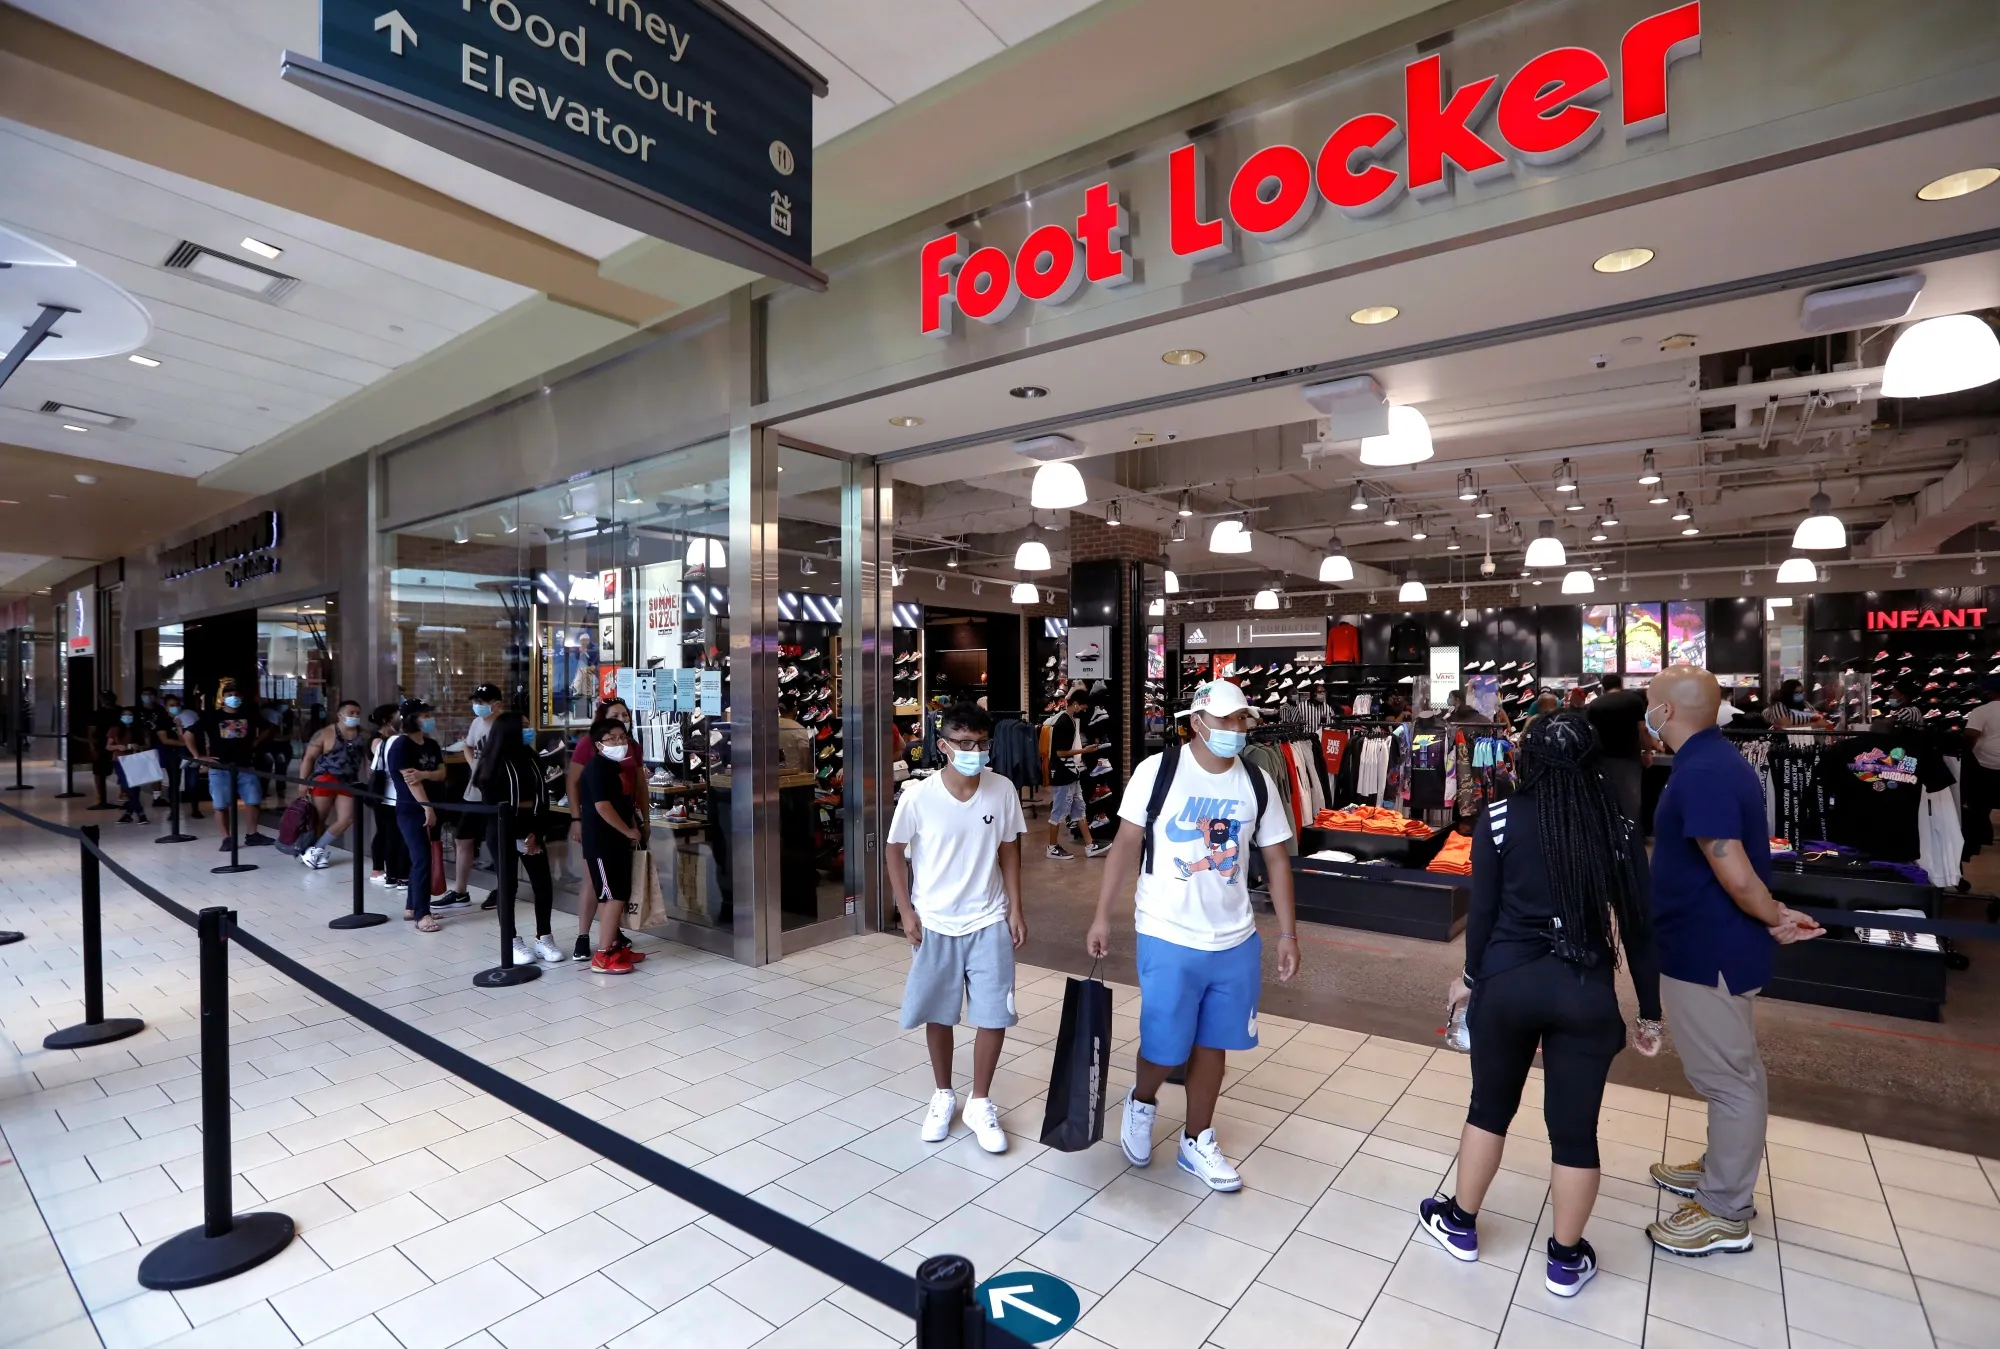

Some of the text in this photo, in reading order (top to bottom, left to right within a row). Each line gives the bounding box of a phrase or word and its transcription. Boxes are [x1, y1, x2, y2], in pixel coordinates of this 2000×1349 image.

[462, 43, 657, 162] Elevator
[605, 48, 718, 136] Court
[920, 1, 1702, 336] Foot Locker
[1867, 608, 1988, 630] INFANT
[1327, 739, 1340, 747] TAKE
[1879, 771, 1913, 784] JORDAN
[1178, 796, 1239, 822] NIKE
